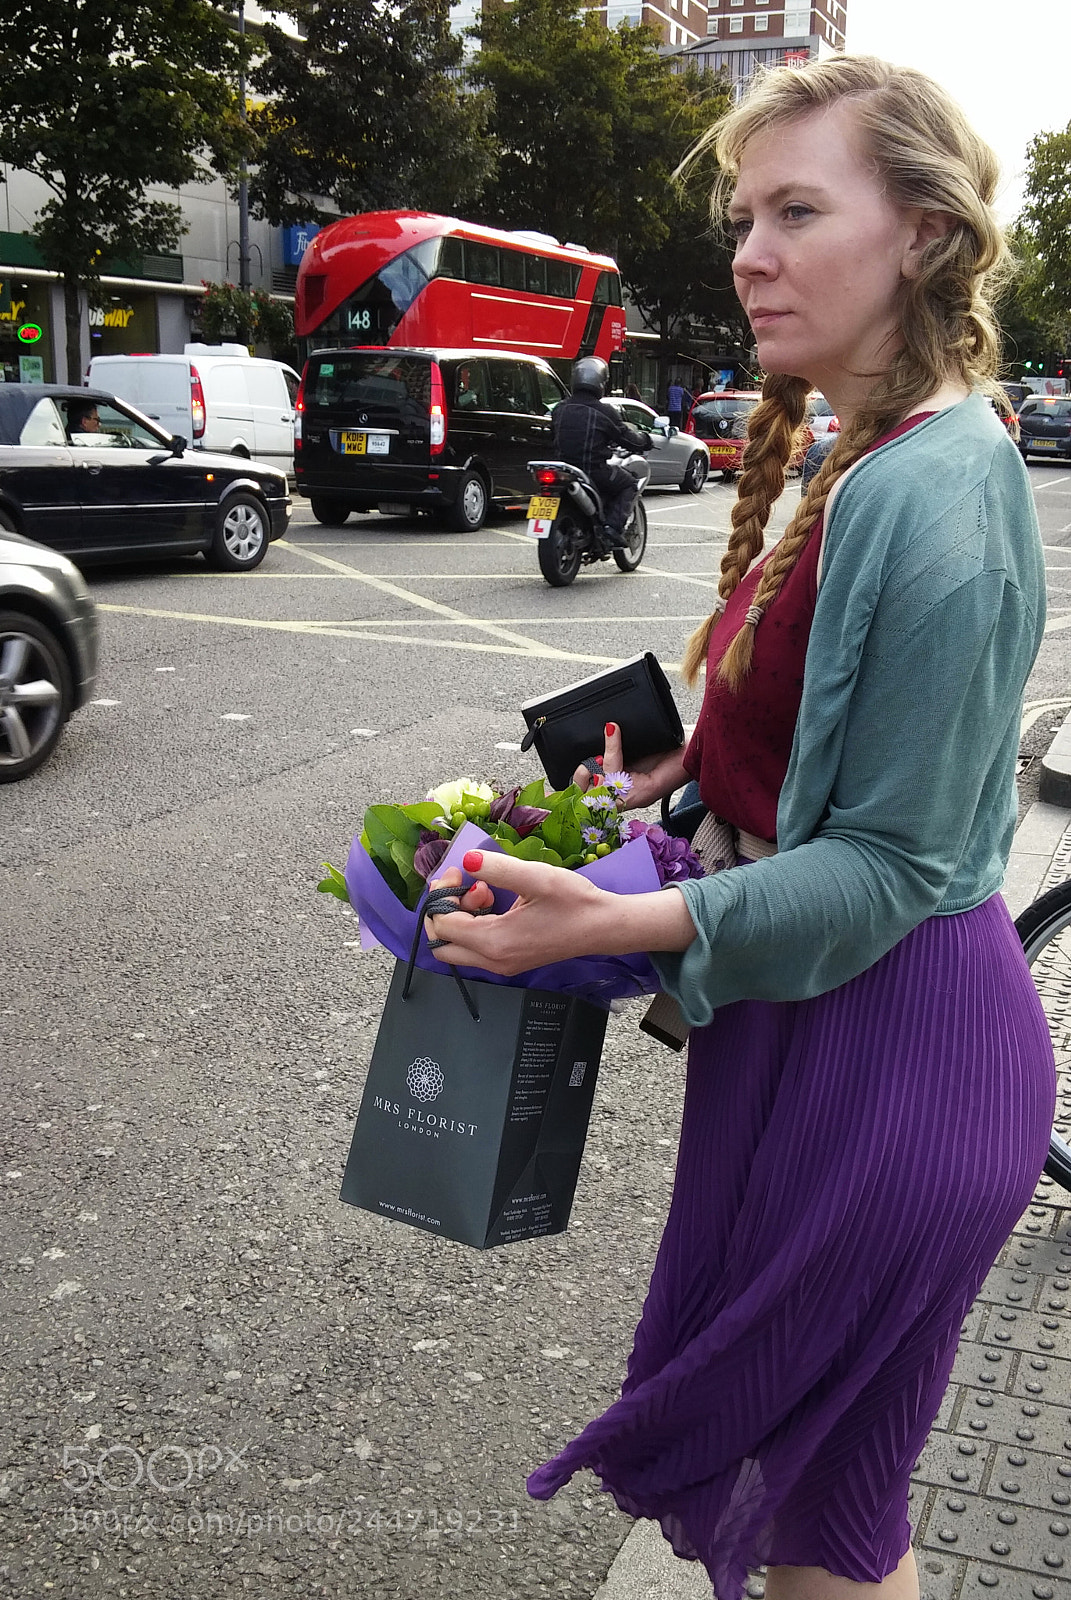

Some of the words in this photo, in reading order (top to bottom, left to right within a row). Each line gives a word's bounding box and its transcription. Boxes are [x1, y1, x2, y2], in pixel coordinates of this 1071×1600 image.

[88, 307, 134, 327] UBWAY
[348, 310, 370, 329] 148
[346, 433, 364, 442] KD15
[346, 443, 363, 452] MWG
[533, 519, 544, 533] L
[373, 1096, 400, 1114] MRS
[408, 1109, 478, 1135] FLORIST
[398, 1120, 440, 1138] LONDON
[379, 1202, 441, 1225] www.mrsflorist.com
